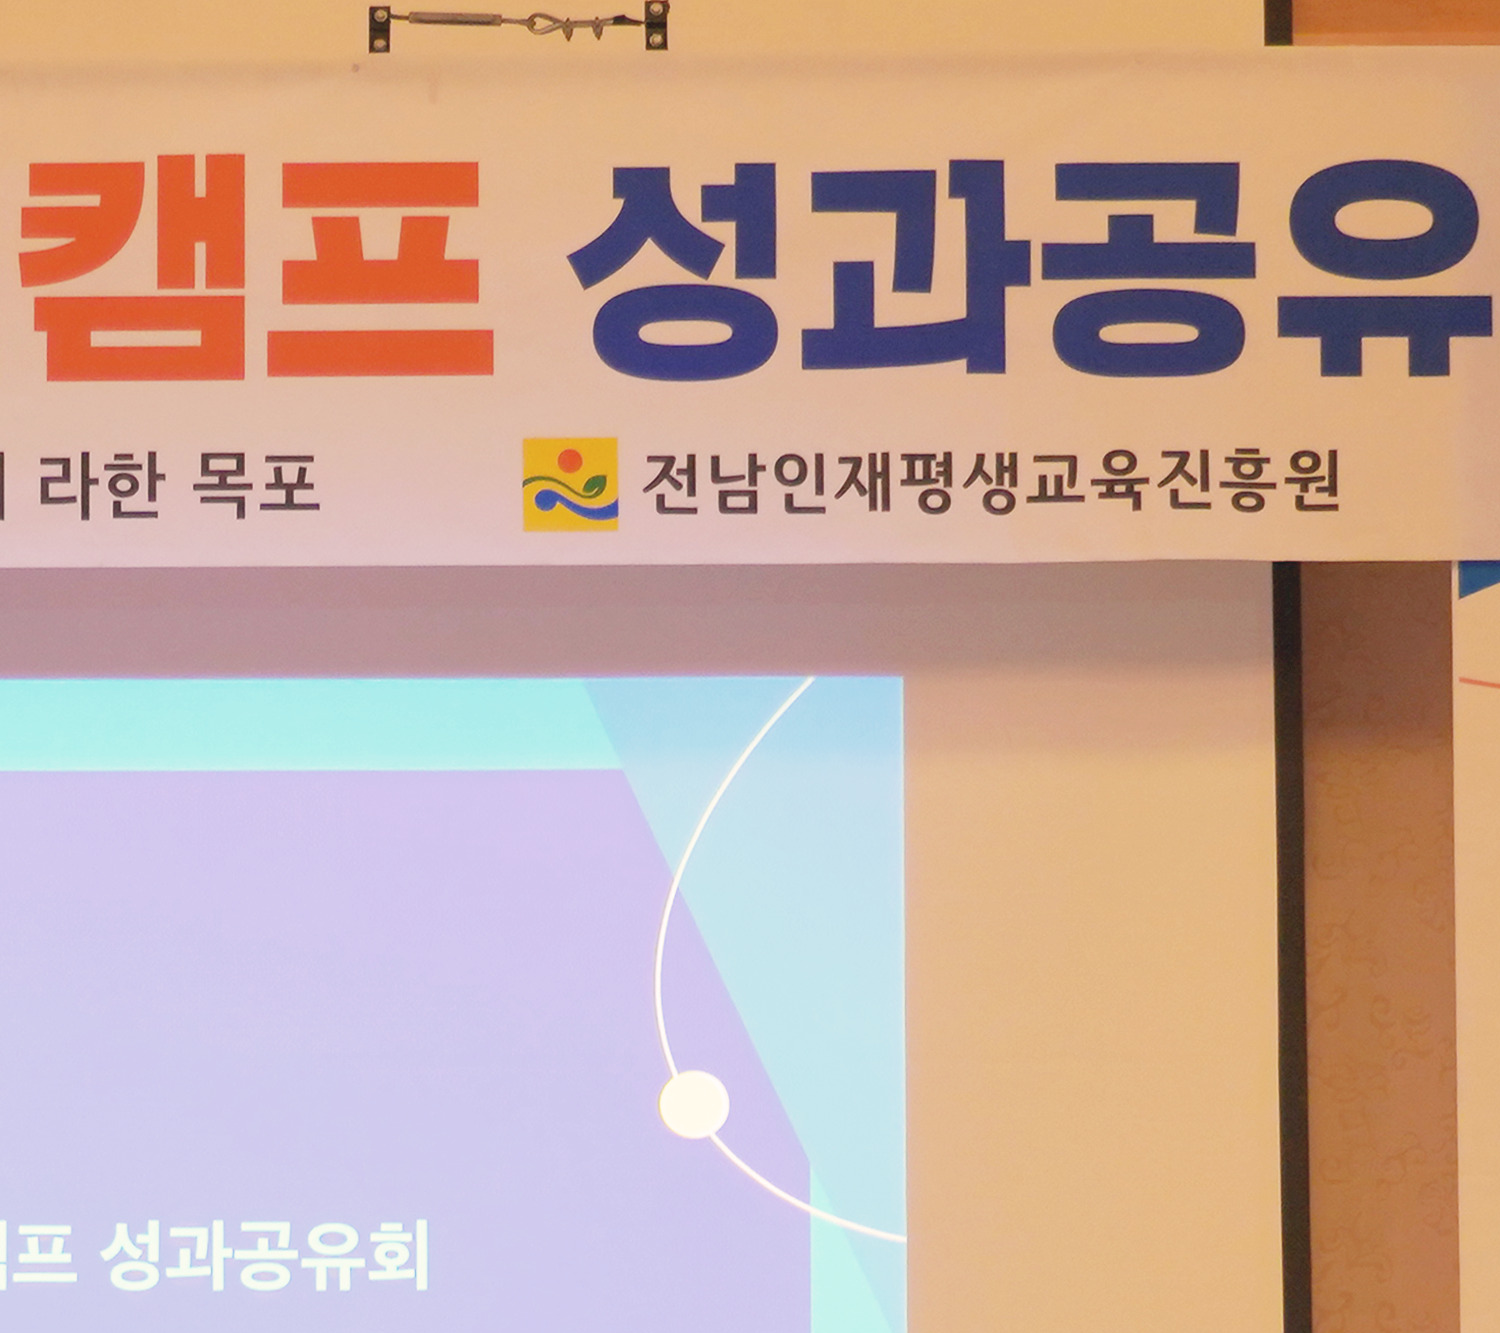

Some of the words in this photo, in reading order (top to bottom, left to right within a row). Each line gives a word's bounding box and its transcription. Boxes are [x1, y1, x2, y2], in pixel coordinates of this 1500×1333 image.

[40, 451, 166, 521] 라한
[193, 452, 320, 519] 목포
[643, 448, 1339, 515] 전남인재평생교육진흥원
[100, 1219, 427, 1291] 성과공유회
